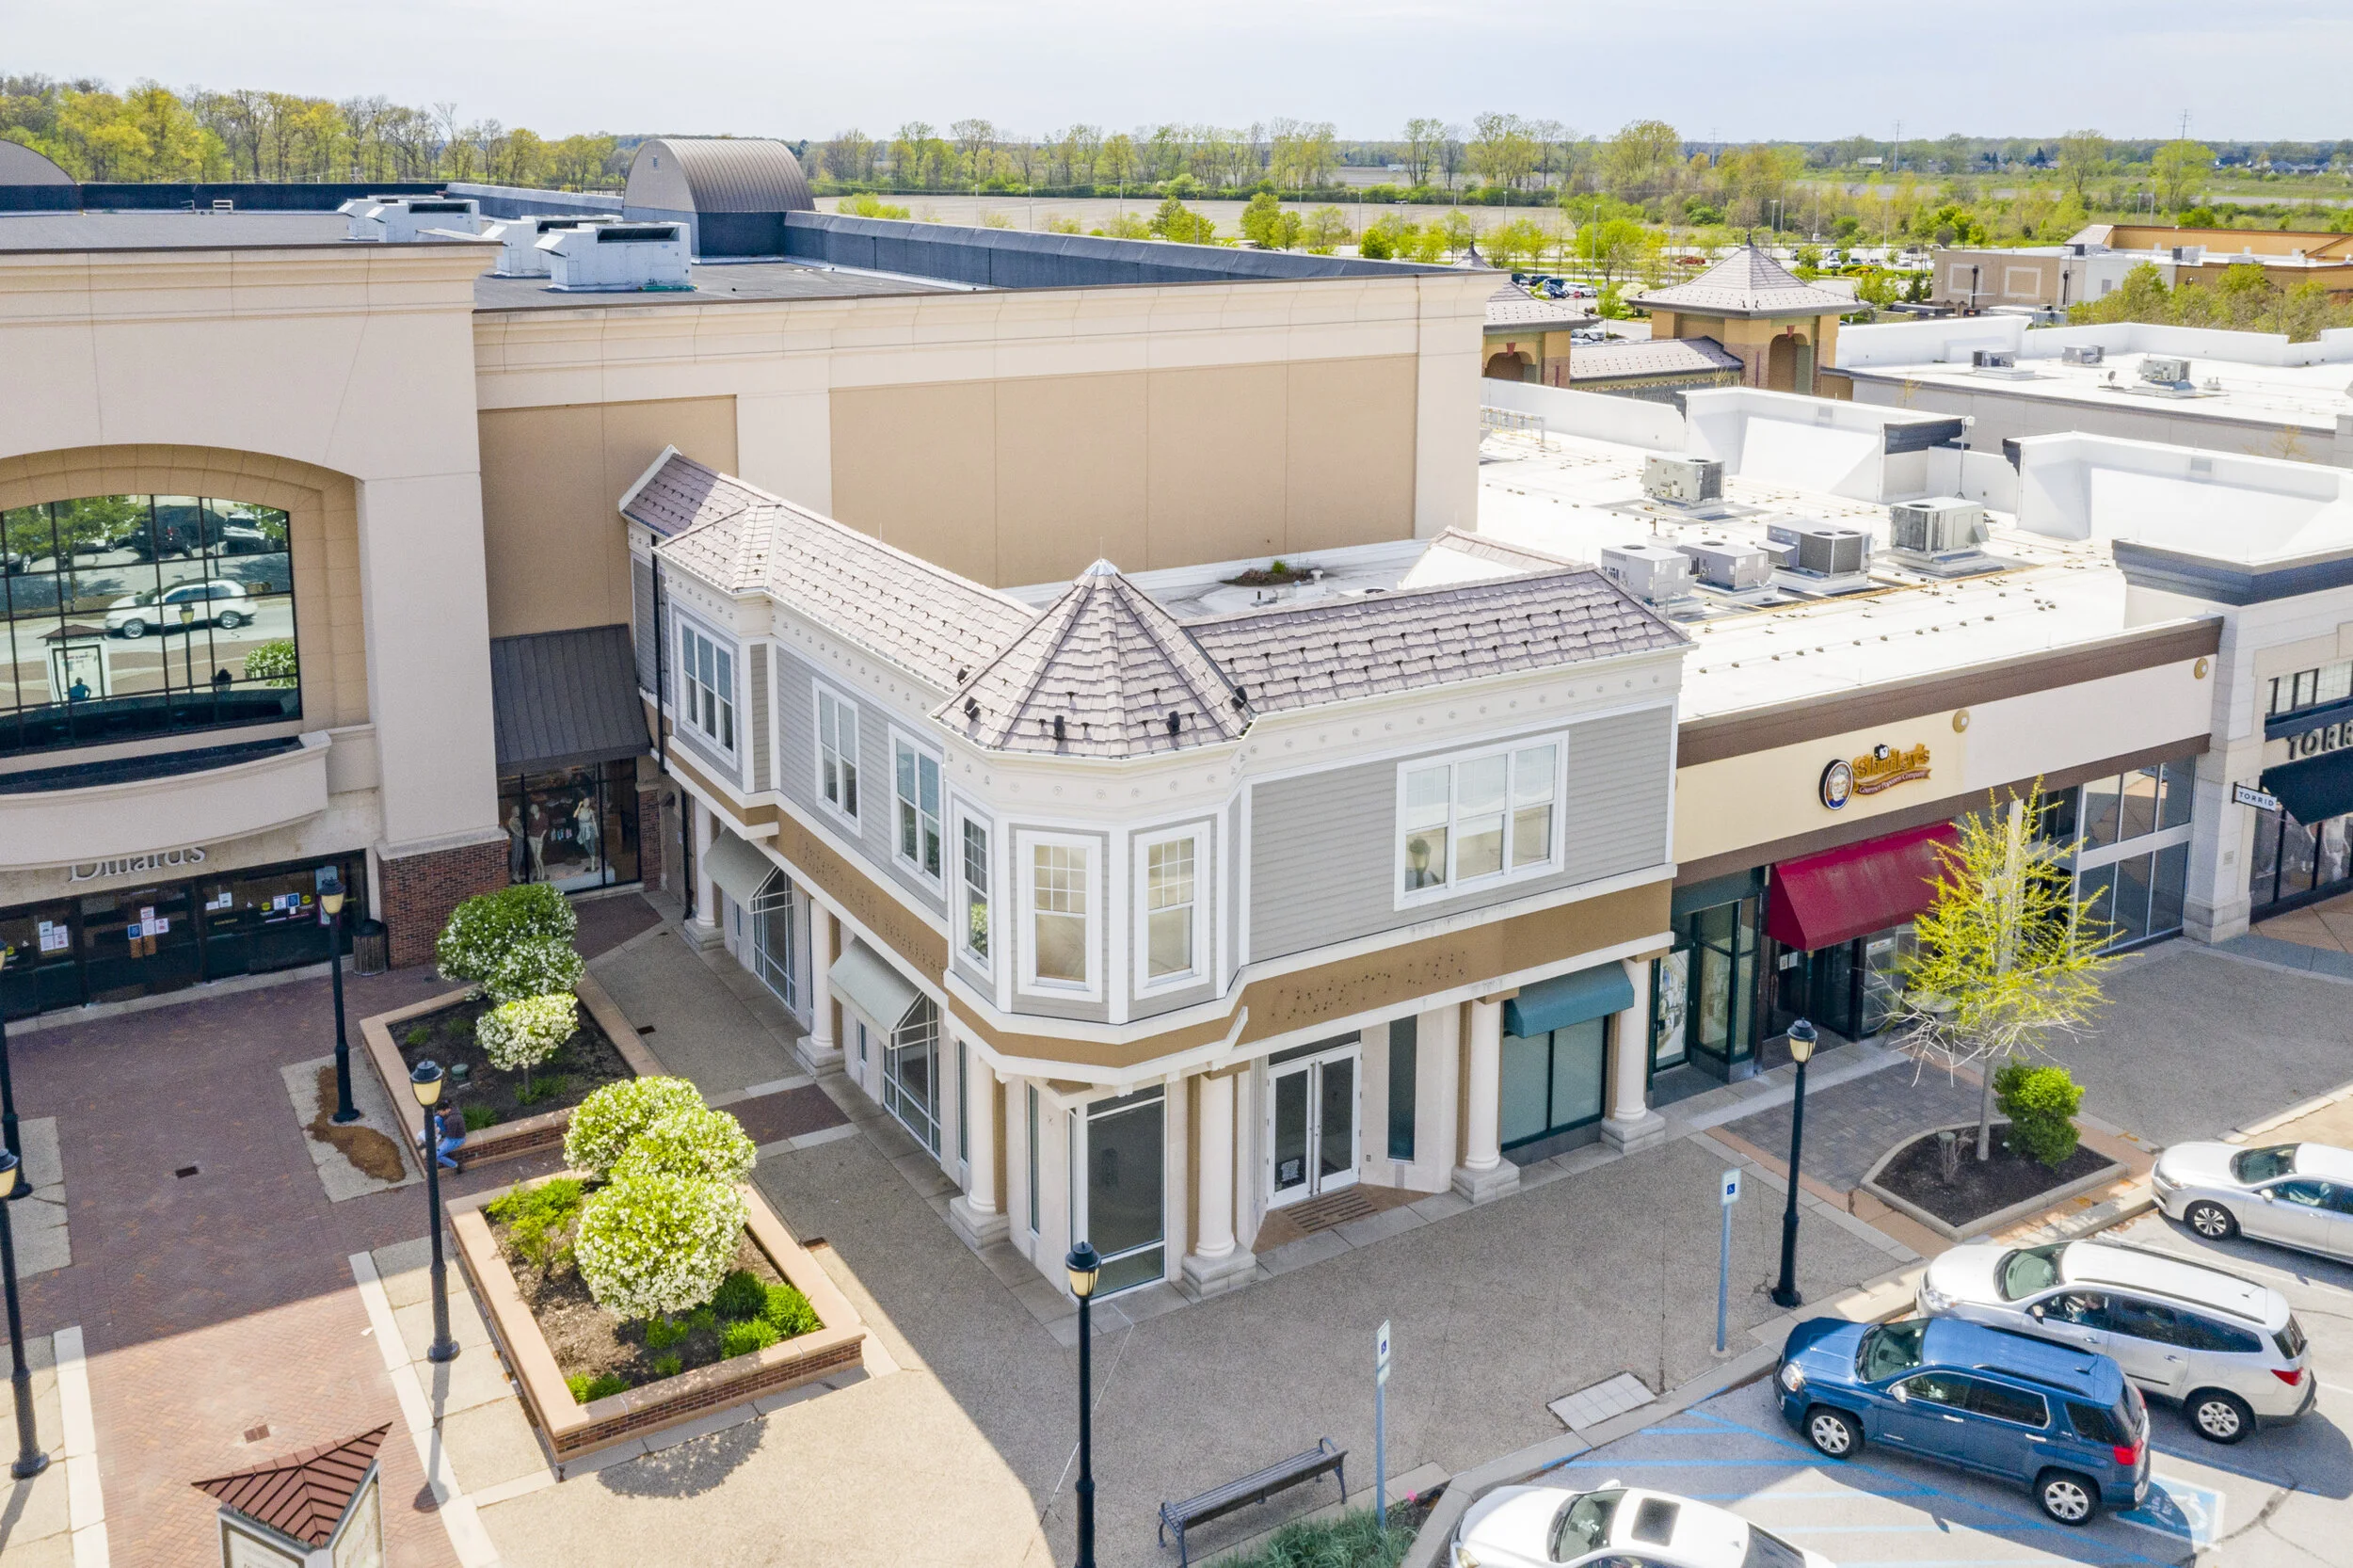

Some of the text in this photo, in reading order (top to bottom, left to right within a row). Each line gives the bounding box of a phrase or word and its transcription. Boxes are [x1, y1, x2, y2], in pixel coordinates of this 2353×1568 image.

[1853, 744, 1929, 778] Shirley's
[1859, 770, 1926, 794] Gourmet Popcorn Company
[2239, 792, 2275, 807] TORRID
